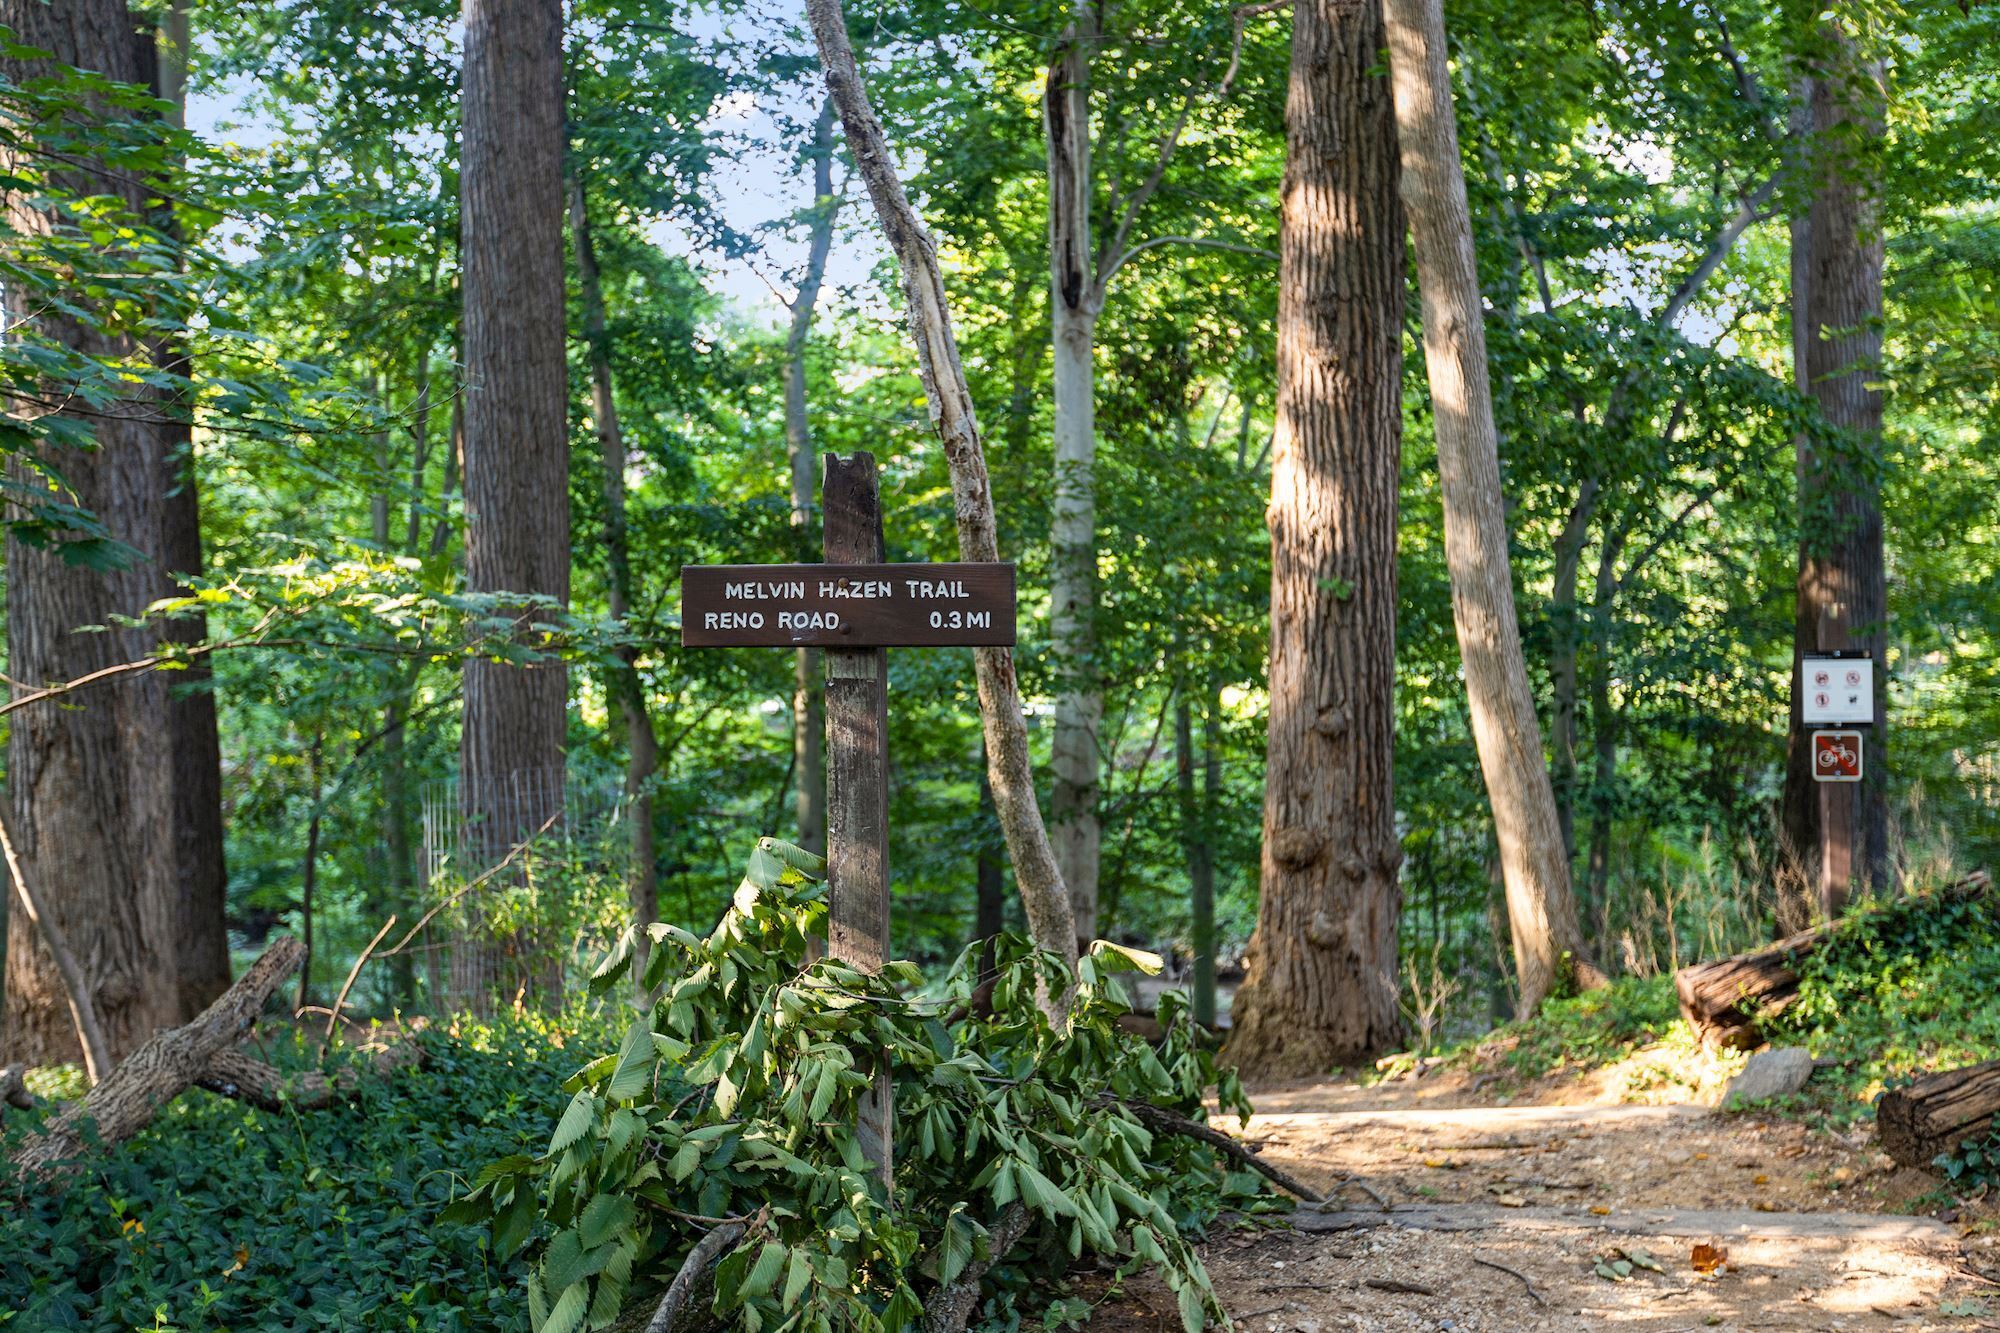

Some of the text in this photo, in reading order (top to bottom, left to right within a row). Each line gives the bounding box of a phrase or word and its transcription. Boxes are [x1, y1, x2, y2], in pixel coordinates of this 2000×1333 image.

[725, 581, 805, 600] MELVIN
[905, 580, 970, 599] TRAIL
[704, 611, 840, 630] RENO ROAD
